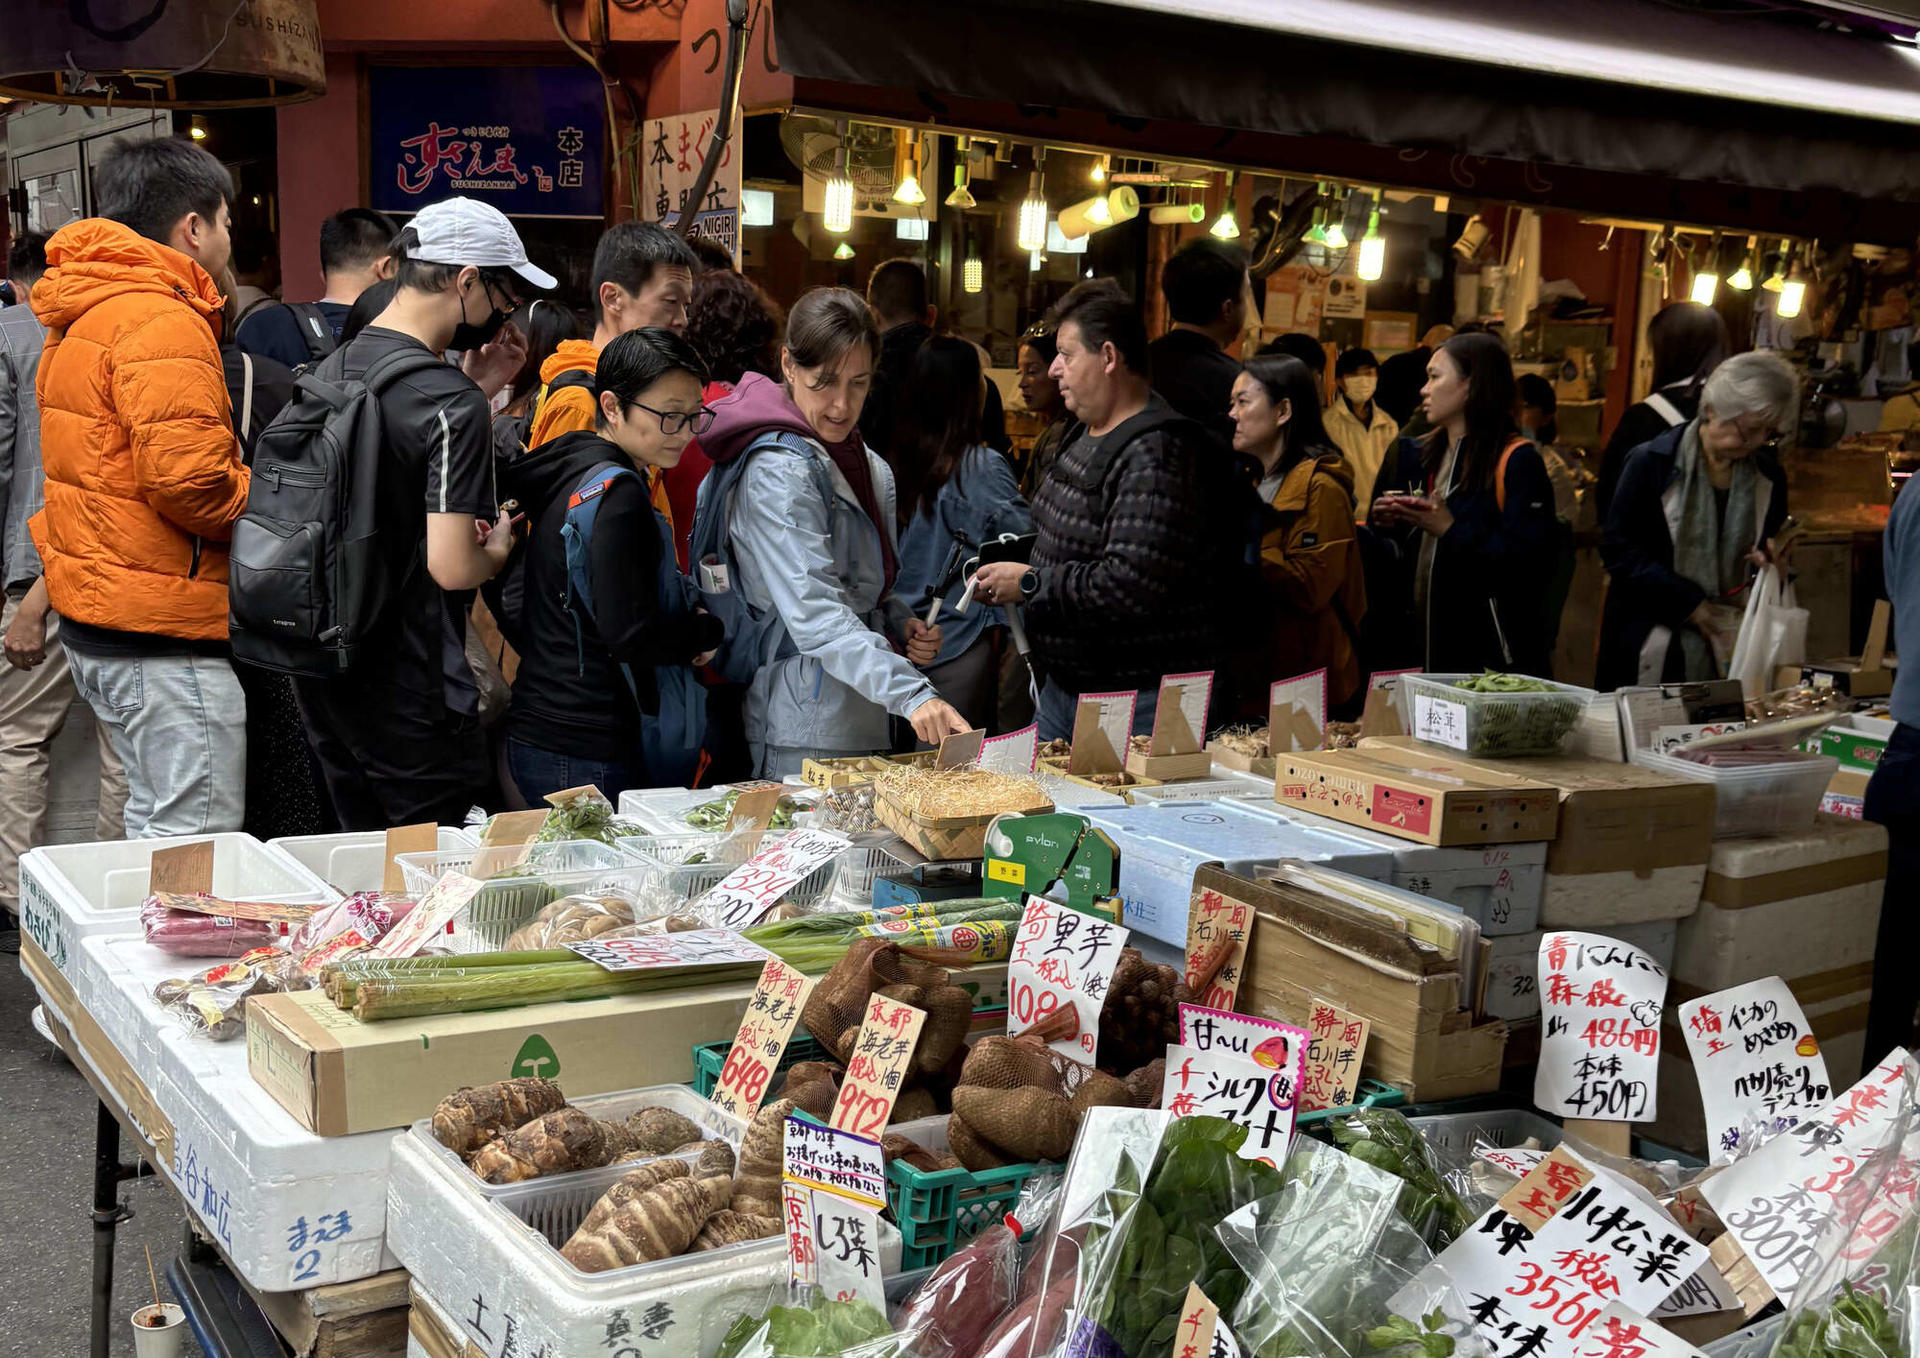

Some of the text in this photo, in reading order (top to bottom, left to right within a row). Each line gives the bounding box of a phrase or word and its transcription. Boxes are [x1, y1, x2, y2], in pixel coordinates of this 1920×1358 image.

[557, 127, 584, 188] 本店
[704, 214, 734, 234] NIGIRI
[1044, 911, 1114, 970] 里芋
[868, 999, 913, 1040] 京都
[1578, 1017, 1659, 1057] 486円
[1573, 1052, 1624, 1081] 本体
[1564, 1079, 1648, 1119] 450円
[292, 1248, 321, 1283] 2
